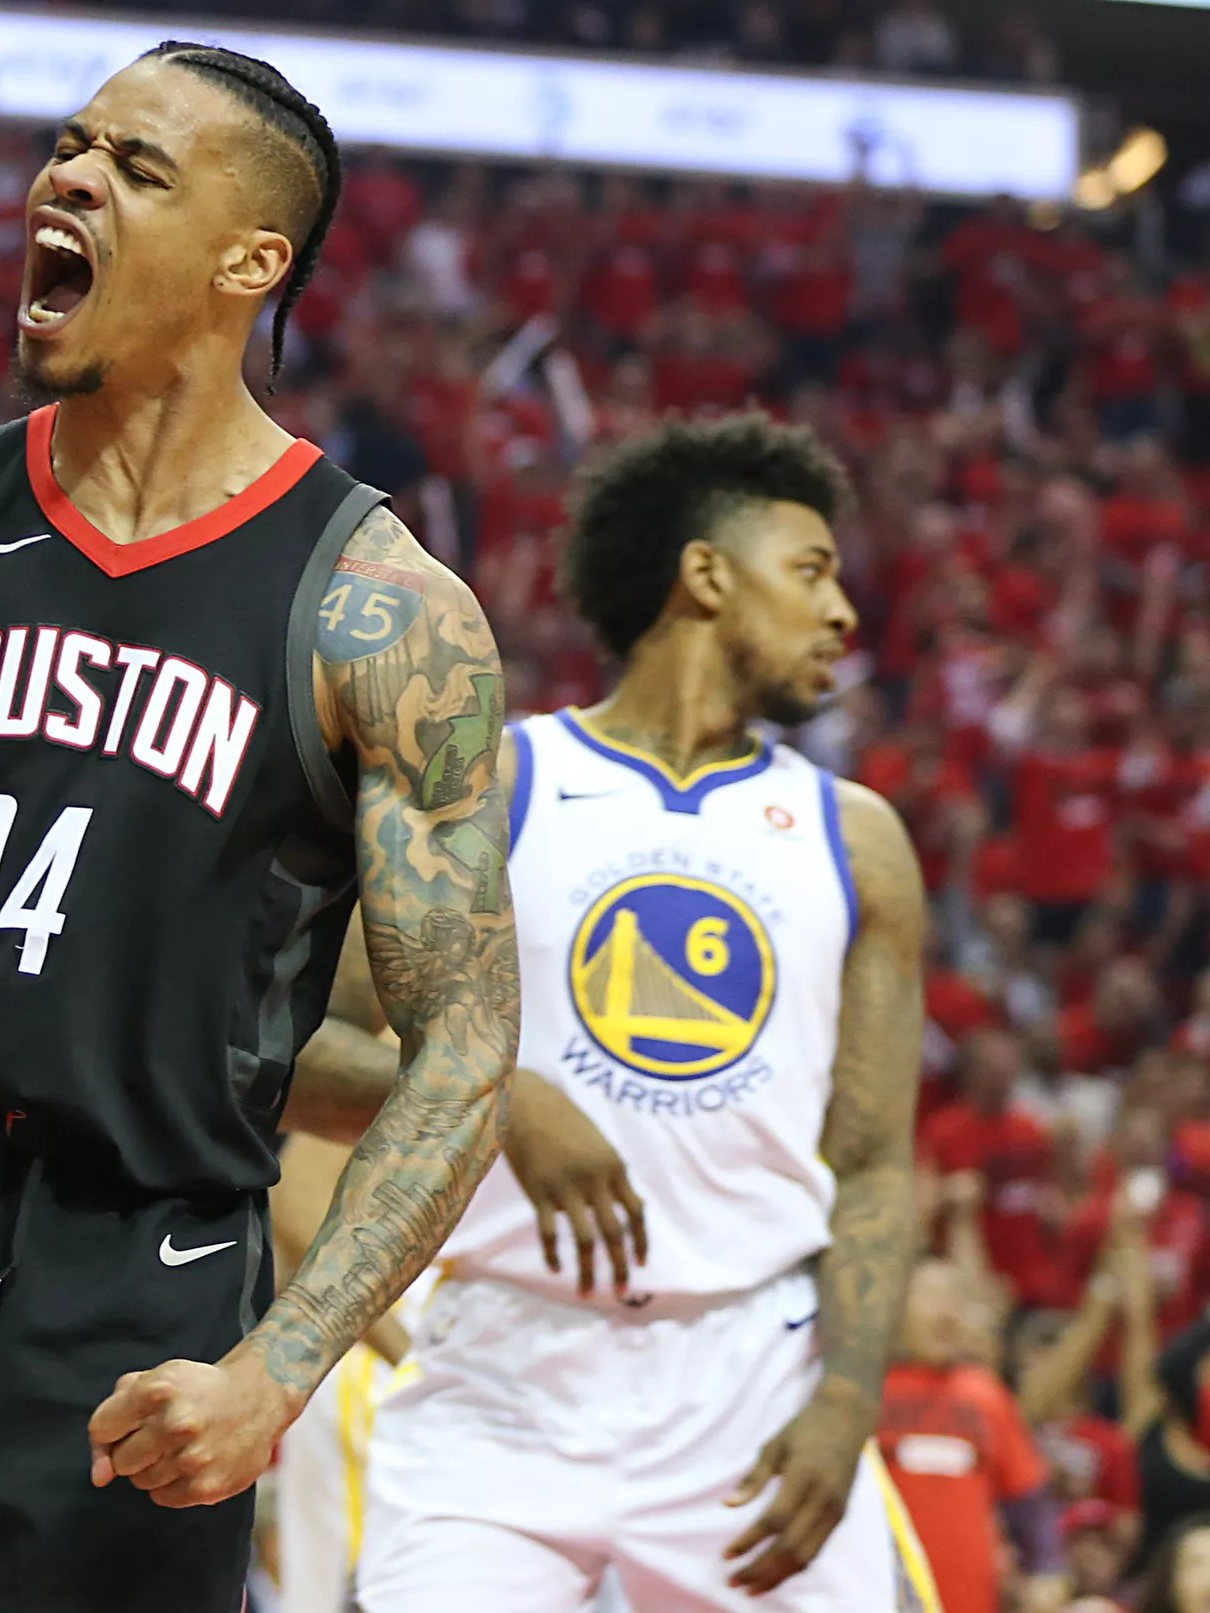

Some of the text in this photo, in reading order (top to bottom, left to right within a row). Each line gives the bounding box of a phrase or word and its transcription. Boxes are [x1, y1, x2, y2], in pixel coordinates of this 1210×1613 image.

[333, 558, 412, 588] INTERSAE
[317, 583, 401, 641] 45
[568, 849, 690, 905] GOLDEN
[685, 916, 731, 976] 6
[561, 1034, 774, 1116] WARRIORS
